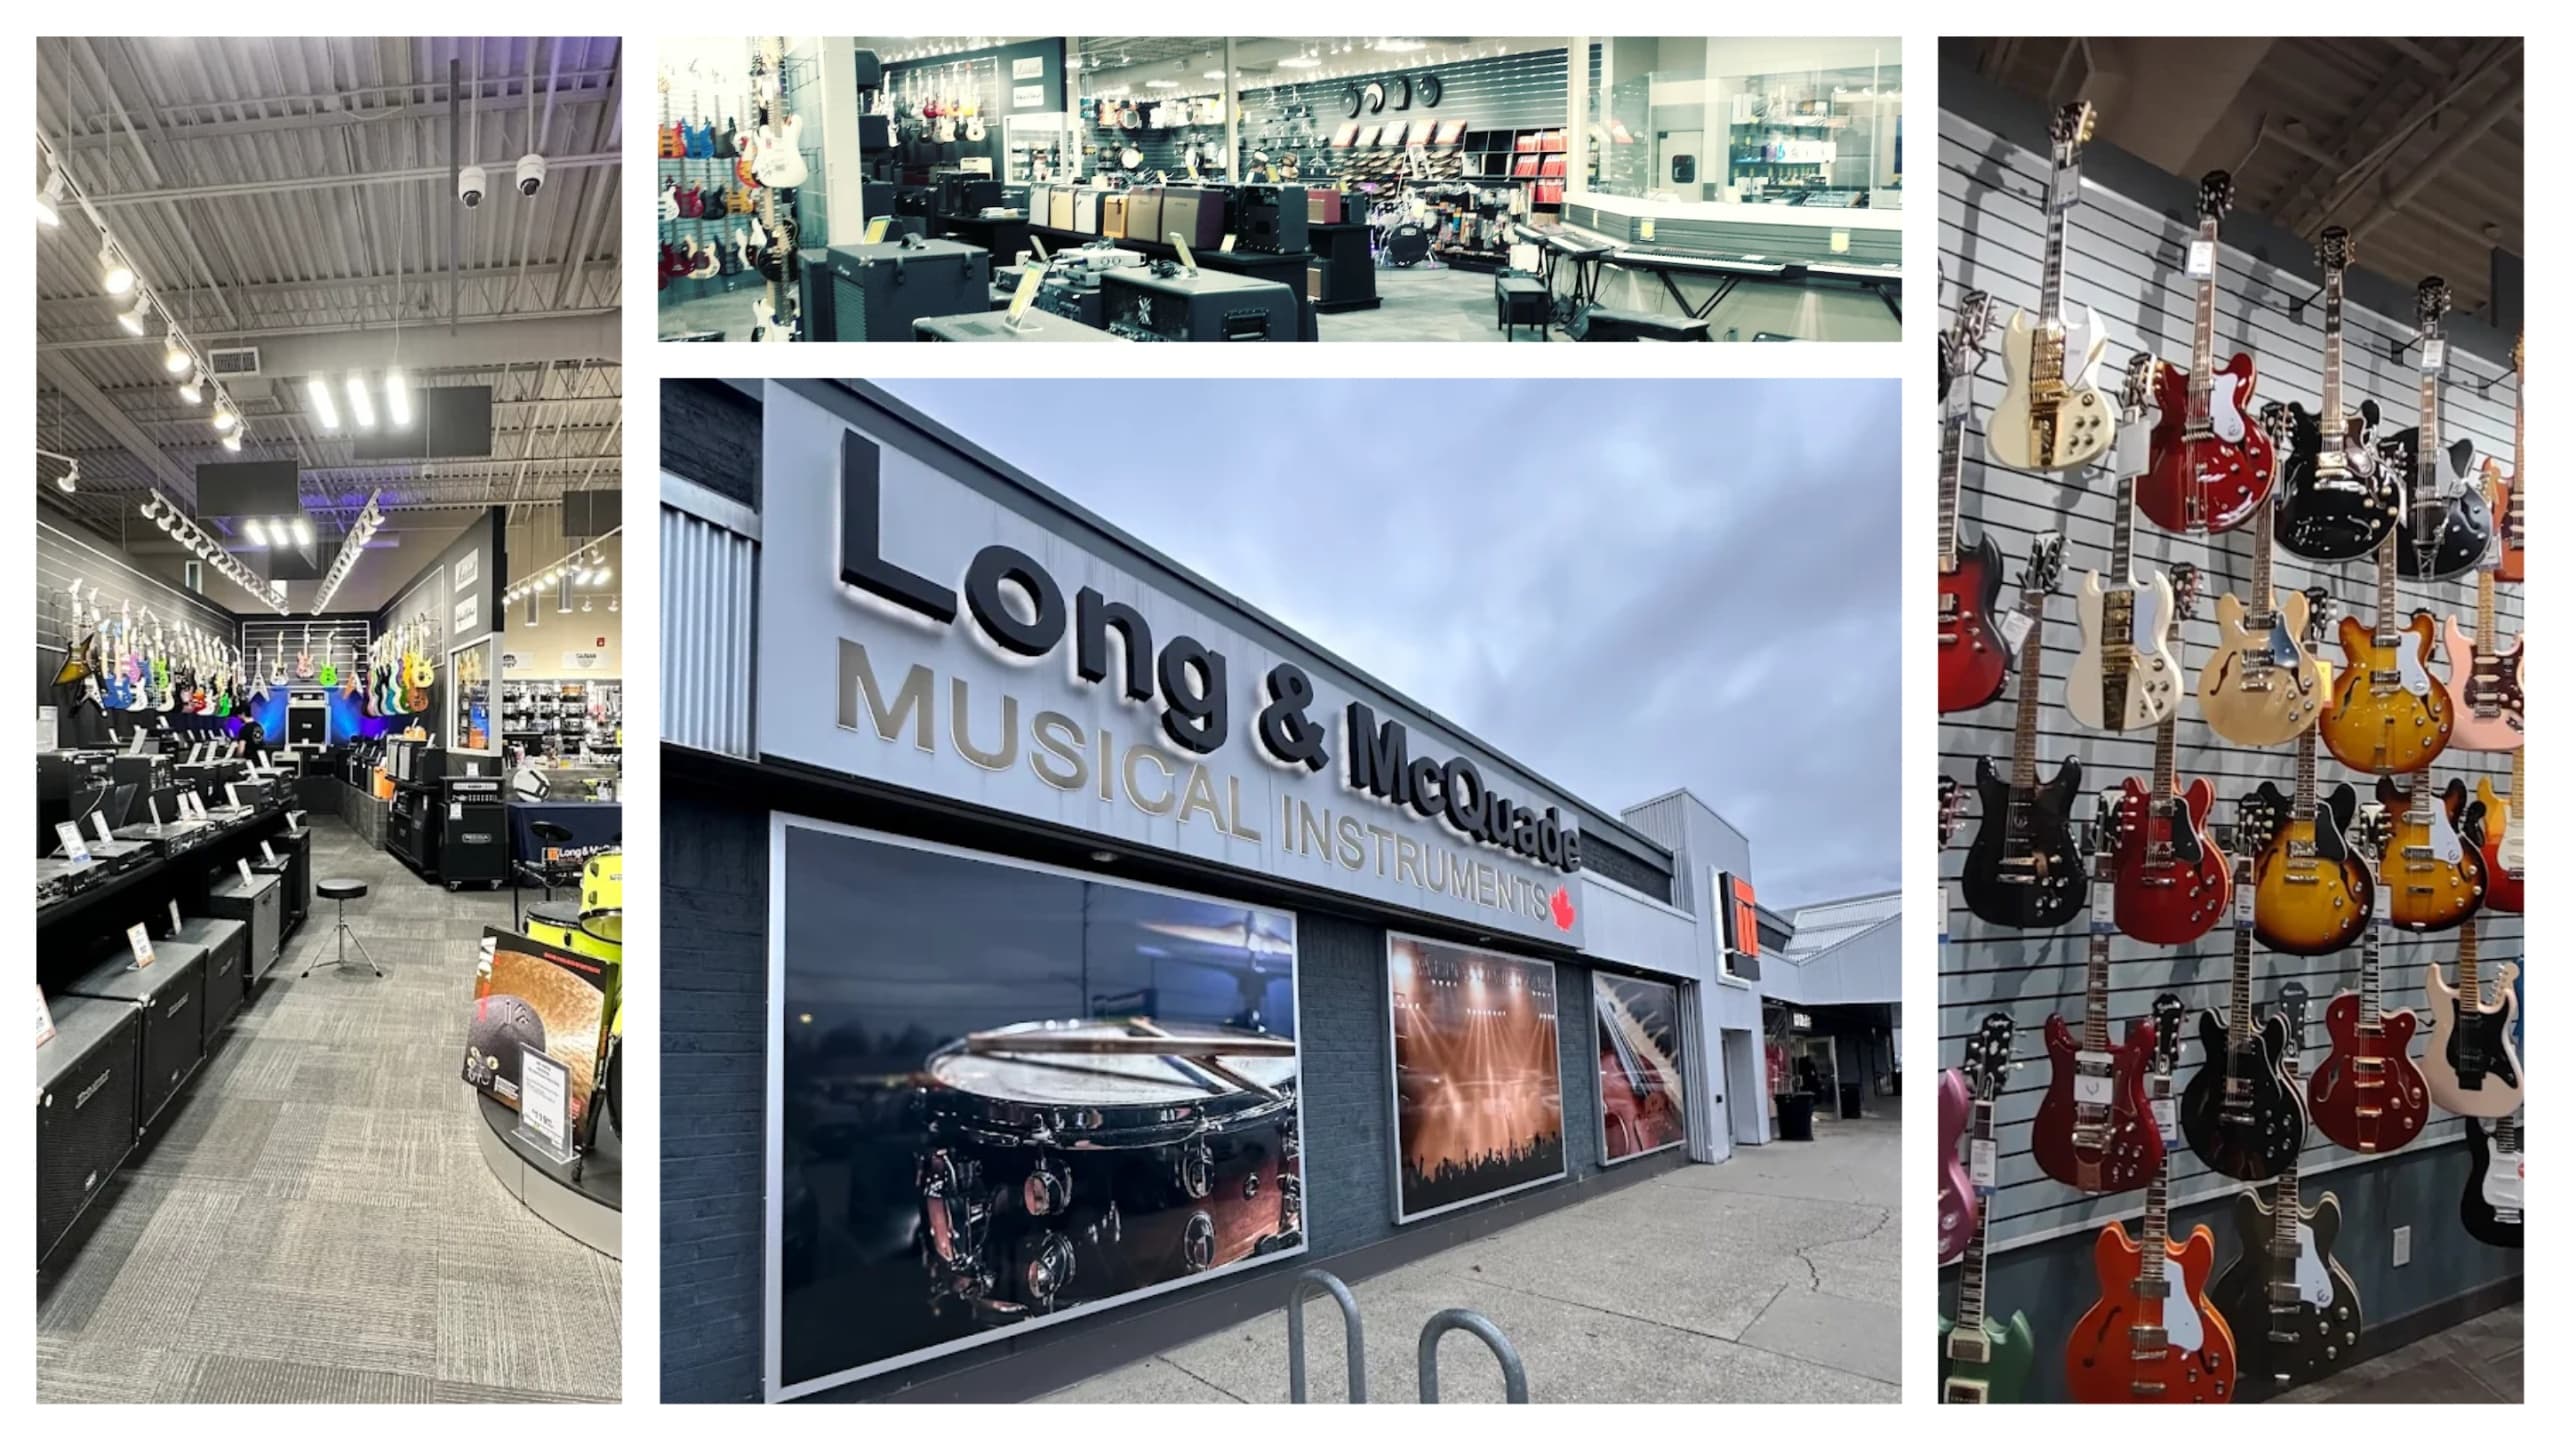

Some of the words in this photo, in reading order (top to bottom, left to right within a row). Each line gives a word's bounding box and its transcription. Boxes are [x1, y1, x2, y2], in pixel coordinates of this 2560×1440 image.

[837, 636, 1262, 845] MUSICAL
[1281, 793, 1550, 923] INSTRUMENTS
[841, 428, 1228, 755] Long
[1259, 662, 1330, 772] &
[1346, 701, 1582, 873] McQuade
[559, 847, 581, 858] Long
[582, 845, 589, 856] &
